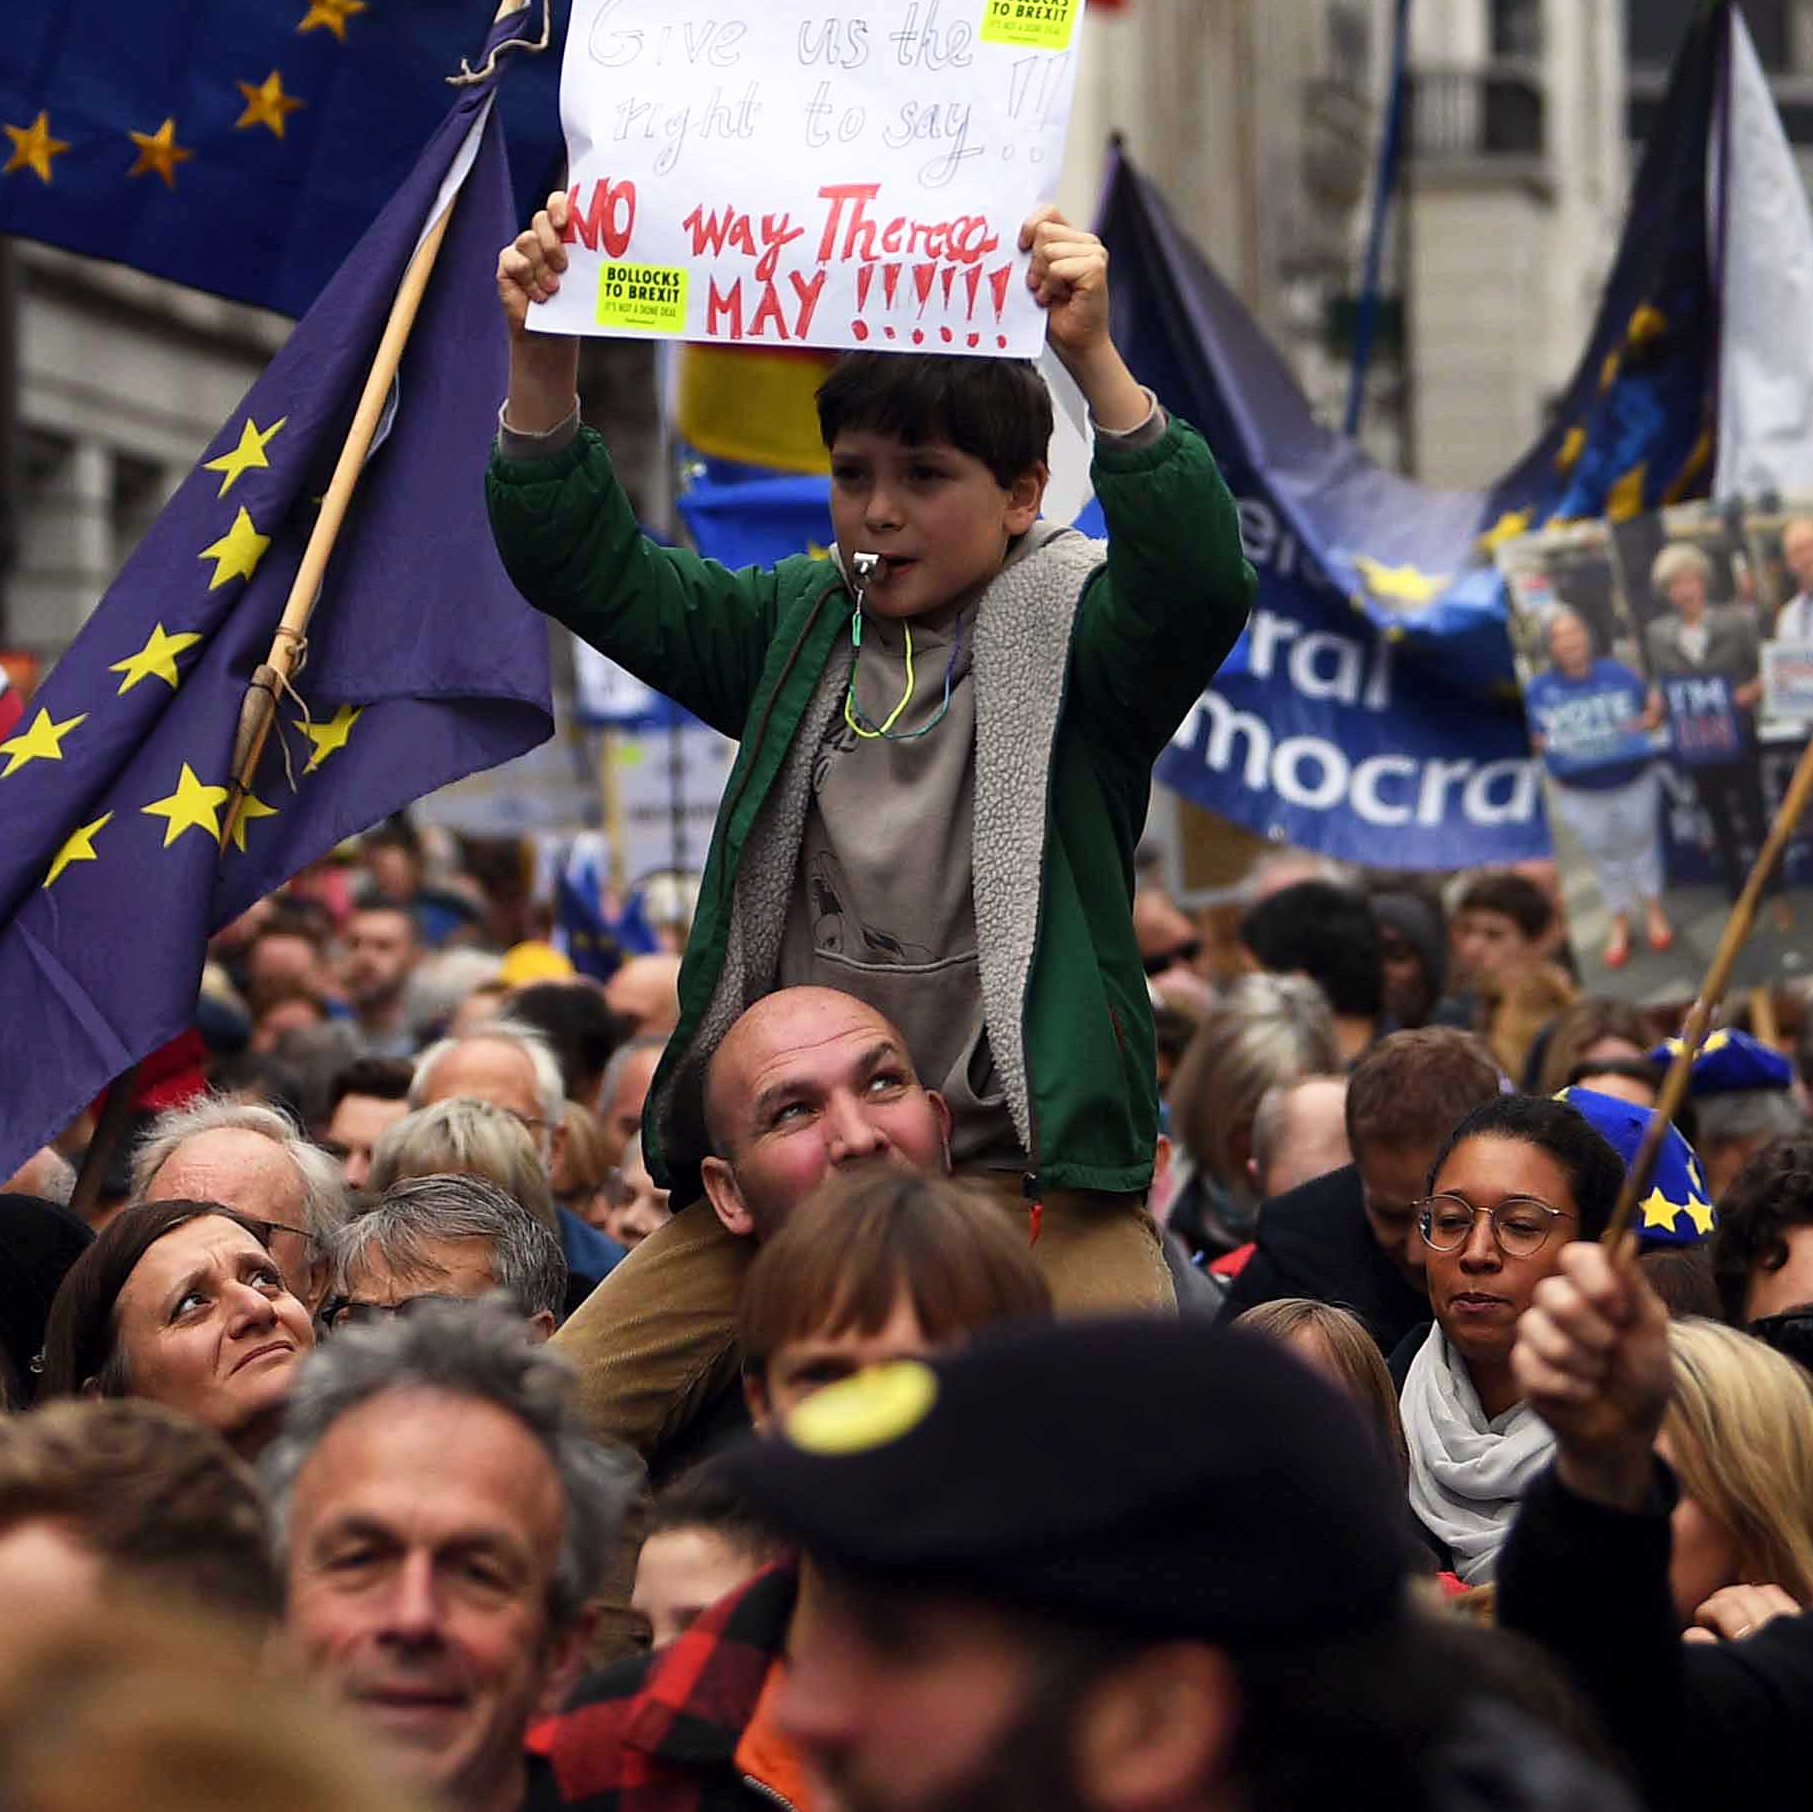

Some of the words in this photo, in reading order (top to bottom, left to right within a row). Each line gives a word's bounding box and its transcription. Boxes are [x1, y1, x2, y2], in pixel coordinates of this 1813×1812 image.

[992, 1, 1010, 16] TO
[1016, 5, 1068, 22] BREXIT
[797, 18, 870, 69] us
[613, 80, 762, 176] right
[804, 80, 866, 148] to
[882, 100, 984, 188] say
[560, 176, 637, 258] NO
[682, 203, 805, 283] way
[605, 283, 623, 298] TO
[628, 284, 680, 303] BREXIT
[607, 267, 680, 286] BOLLOCKS
[706, 268, 826, 342] MAY
